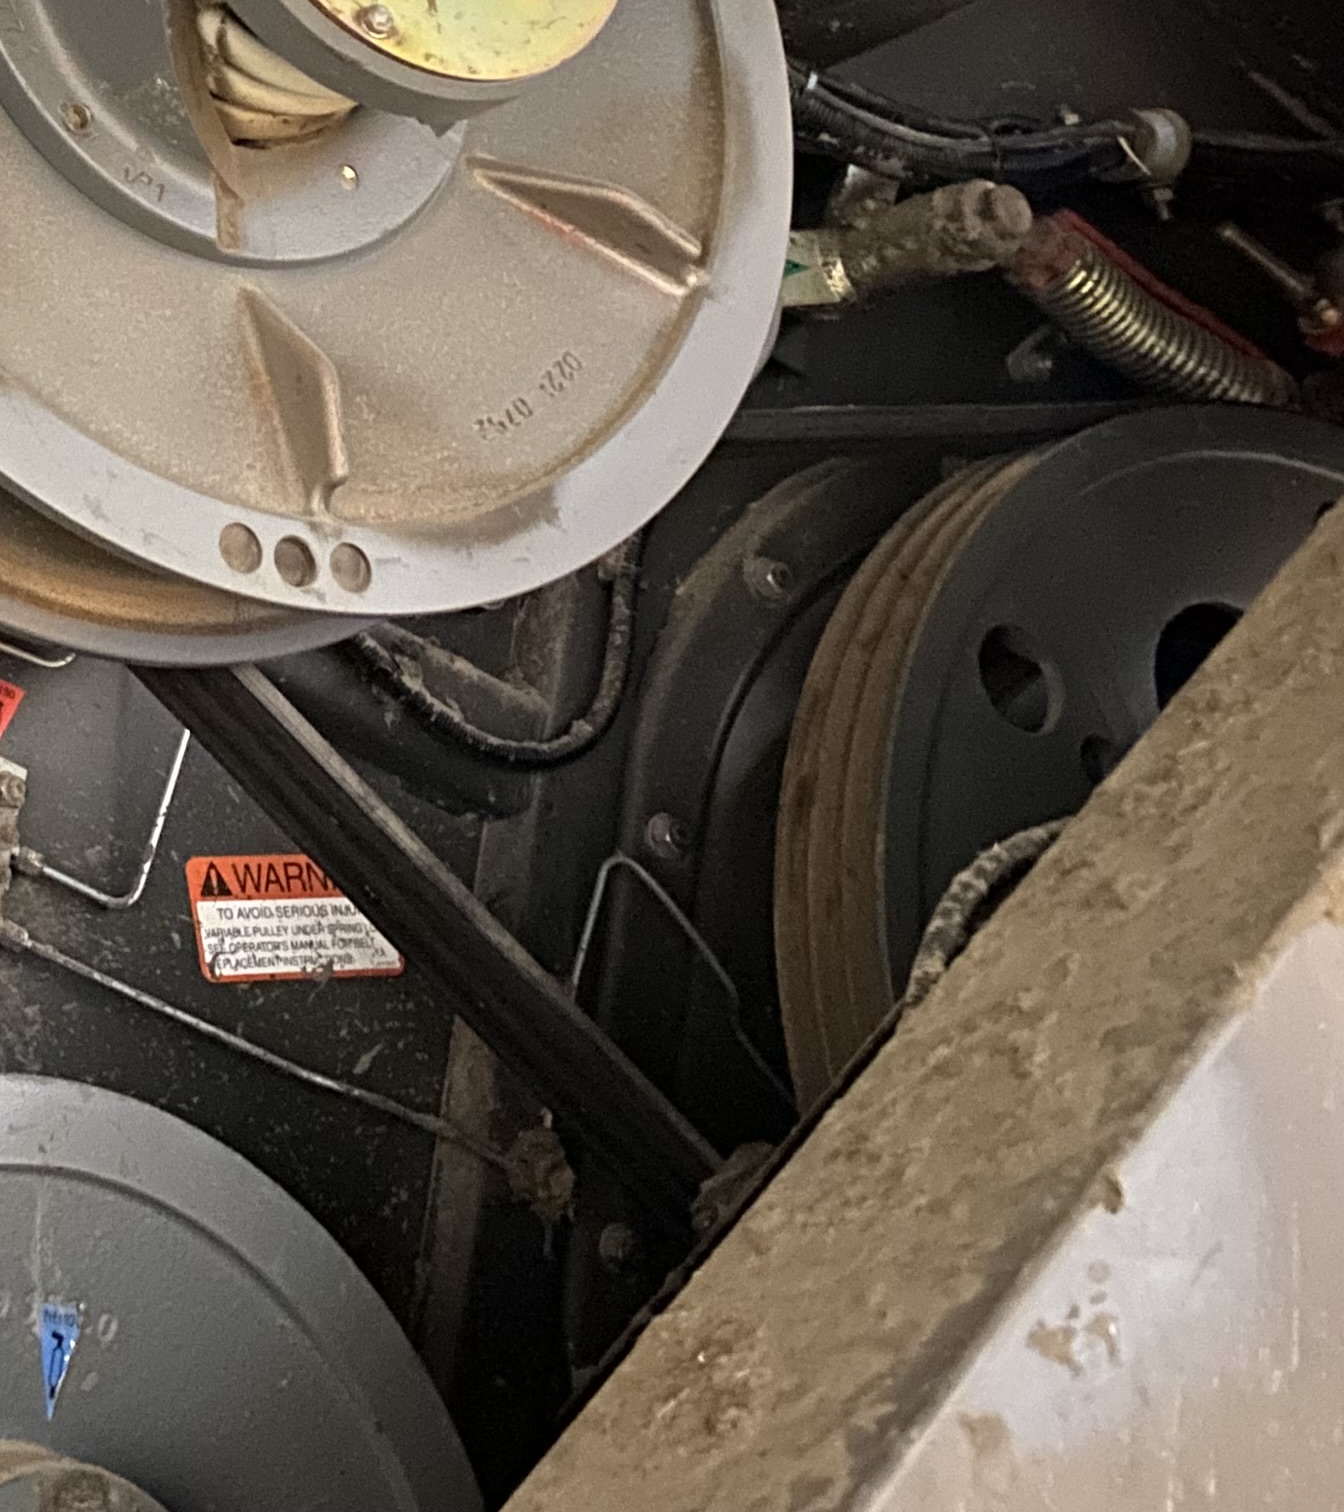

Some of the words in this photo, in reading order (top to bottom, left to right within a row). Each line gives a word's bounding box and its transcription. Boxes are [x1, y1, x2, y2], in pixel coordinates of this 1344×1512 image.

[232, 863, 338, 893] WARN
[217, 908, 233, 920] TO
[237, 907, 273, 919] AVOID
[276, 906, 328, 918] SERIOUS
[205, 927, 250, 938] VARIABLE
[254, 926, 288, 936] PULLEY
[292, 925, 324, 935] UNDER
[326, 924, 361, 934] SPRING
[207, 942, 225, 954] SEE
[229, 940, 288, 952] OPERATOR'S
[291, 939, 329, 950] MANUAL
[332, 938, 351, 949] FOR
[353, 938, 375, 948] BELT
